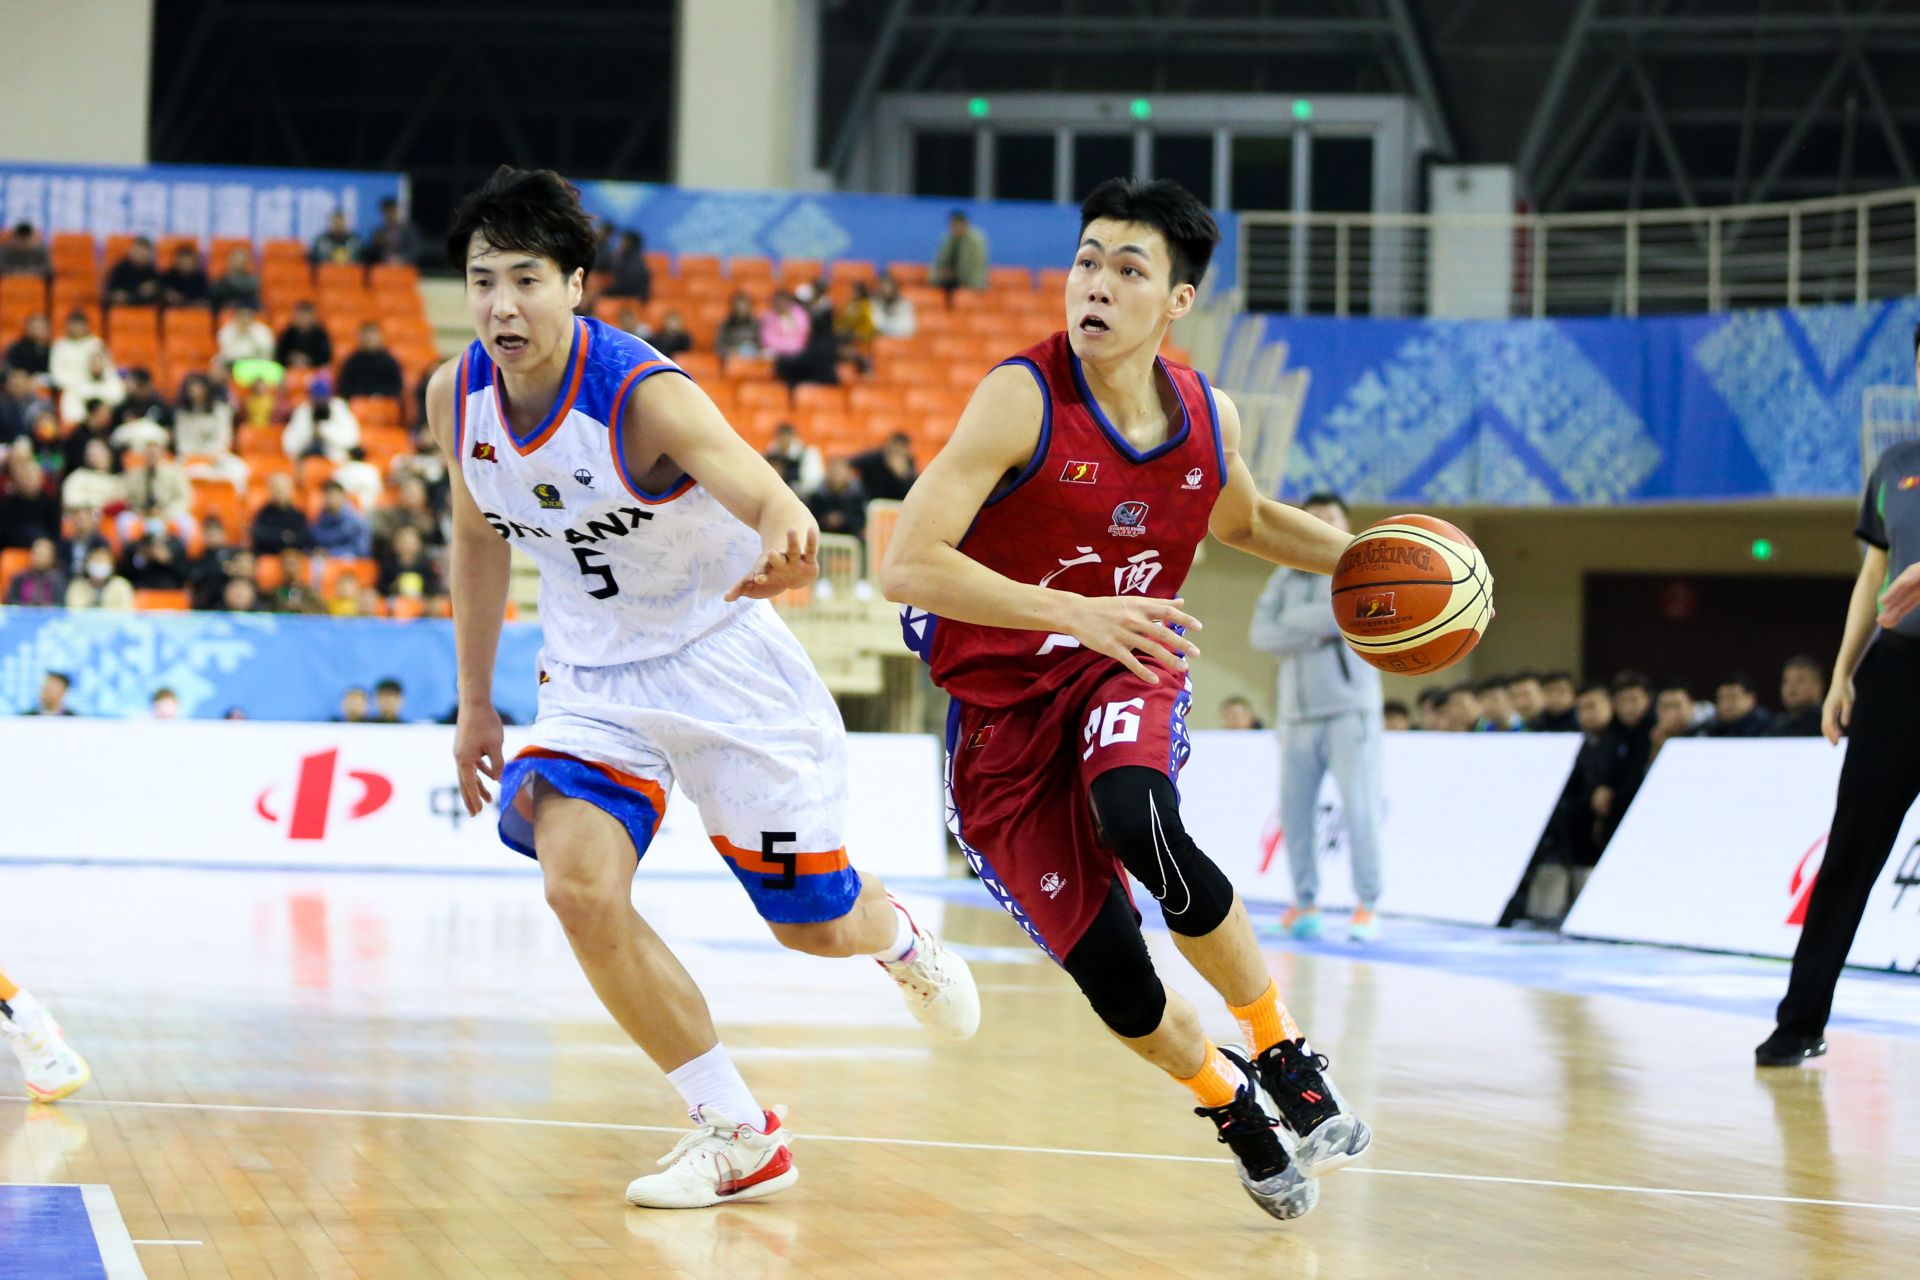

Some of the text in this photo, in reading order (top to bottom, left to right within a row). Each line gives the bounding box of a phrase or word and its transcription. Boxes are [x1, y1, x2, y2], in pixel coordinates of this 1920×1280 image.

[571, 547, 619, 600] 5
[1039, 546, 1163, 597] 广西
[760, 831, 796, 890] 5
